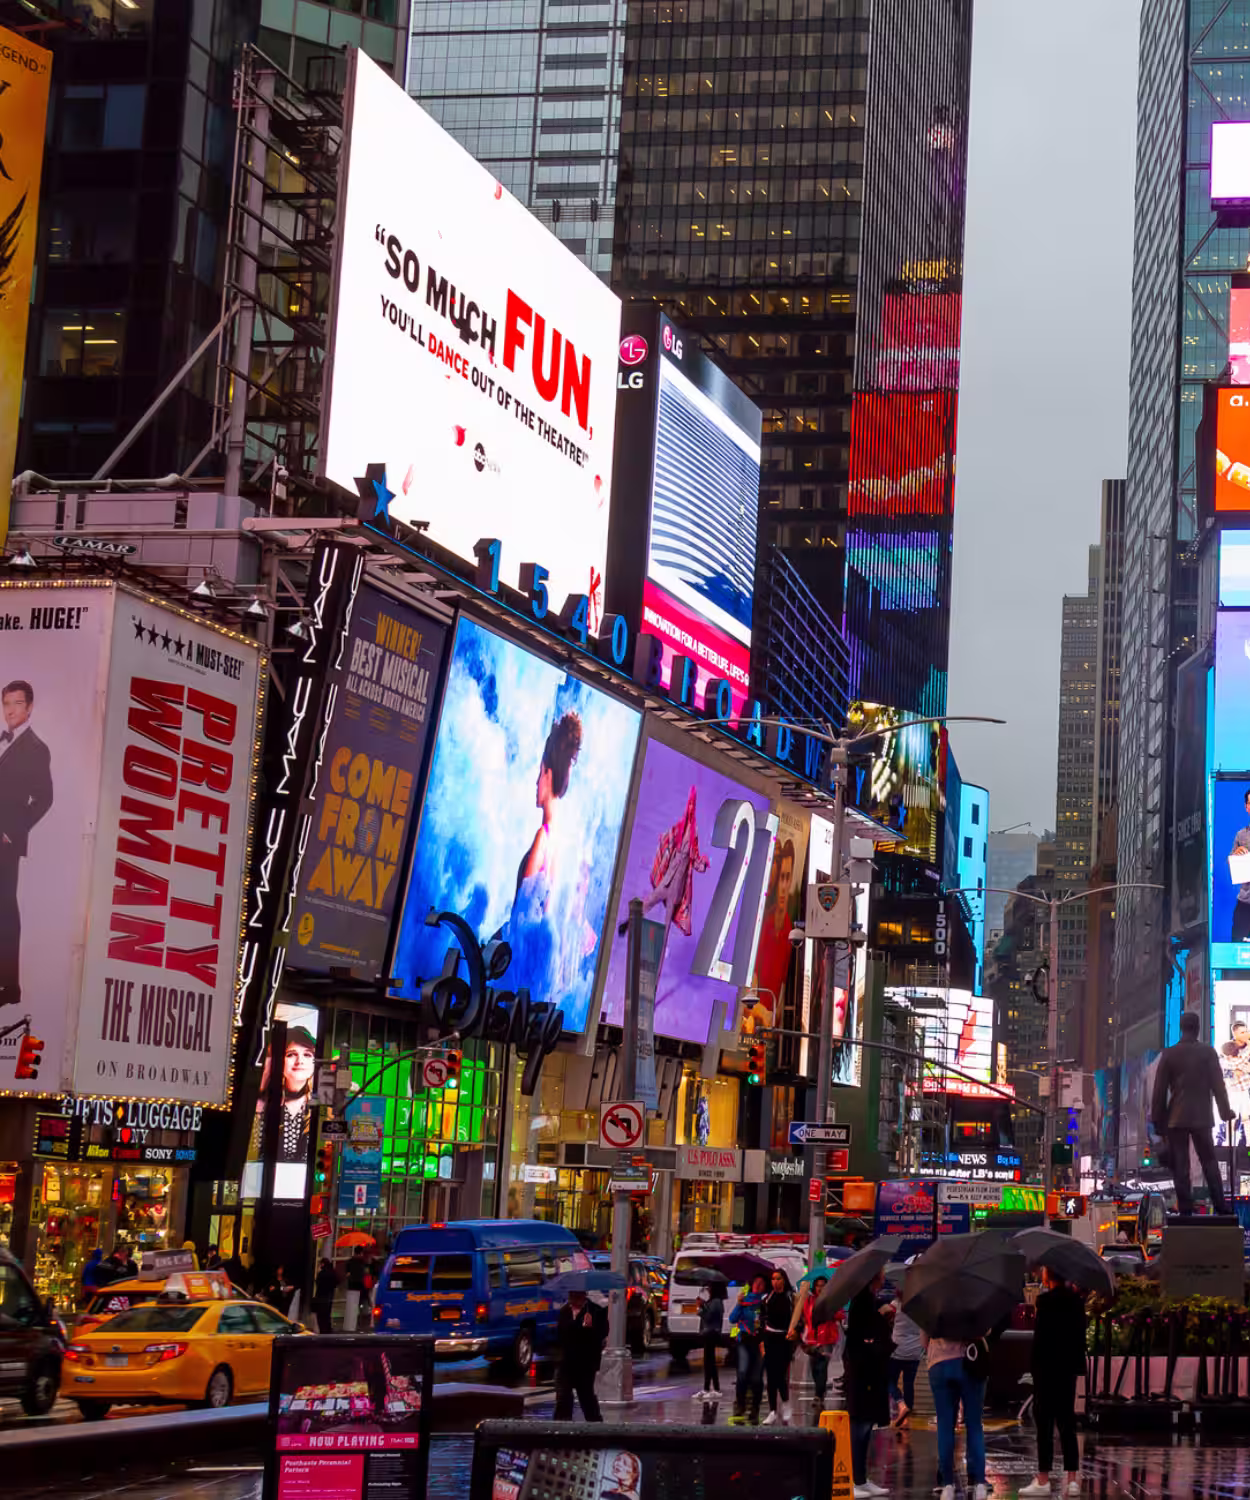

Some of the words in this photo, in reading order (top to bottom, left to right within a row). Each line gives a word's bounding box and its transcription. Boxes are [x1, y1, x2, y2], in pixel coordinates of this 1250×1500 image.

[425, 264, 497, 357] MUCH
[380, 294, 426, 348] YOU'LL
[427, 331, 470, 381] DANCE
[471, 366, 496, 399] OUT
[496, 386, 512, 411] OF
[513, 398, 536, 431] THE
[671, 335, 684, 360] LG
[617, 372, 644, 389] LG
[60, 538, 130, 553] LAMAR
[186, 639, 194, 662] A
[376, 610, 422, 663] WINNER!
[643, 605, 682, 645] INNOVATION
[681, 632, 694, 651] FOR
[692, 637, 699, 653] A
[349, 636, 383, 681] BEST
[380, 651, 430, 704] MUSICAL
[345, 674, 359, 694] ALL
[358, 678, 383, 704] ACROSS
[382, 689, 402, 713] NORTH
[401, 696, 427, 723] AMERICA
[330, 745, 414, 815] COME
[107, 675, 186, 969] WOMAN
[165, 686, 238, 989] PRETTY
[307, 843, 397, 910] AWAY
[705, 798, 780, 988] 21
[934, 900, 947, 955] 1500
[101, 977, 135, 1043] THE
[137, 983, 213, 1053] MUSICAL
[97, 1059, 119, 1078] ON
[126, 1061, 211, 1087] BROADWAY
[61, 1098, 114, 1125] GIFTS
[126, 1102, 203, 1132] LUGGAGE
[130, 1128, 150, 1144] NY
[799, 1128, 819, 1138] ONE
[823, 1128, 844, 1138] WAY
[145, 1148, 173, 1160] SONY
[699, 1150, 720, 1167] POLO
[958, 1153, 988, 1166] NEWS
[309, 1436, 334, 1447] NOW
[337, 1435, 385, 1447] PLAYING
